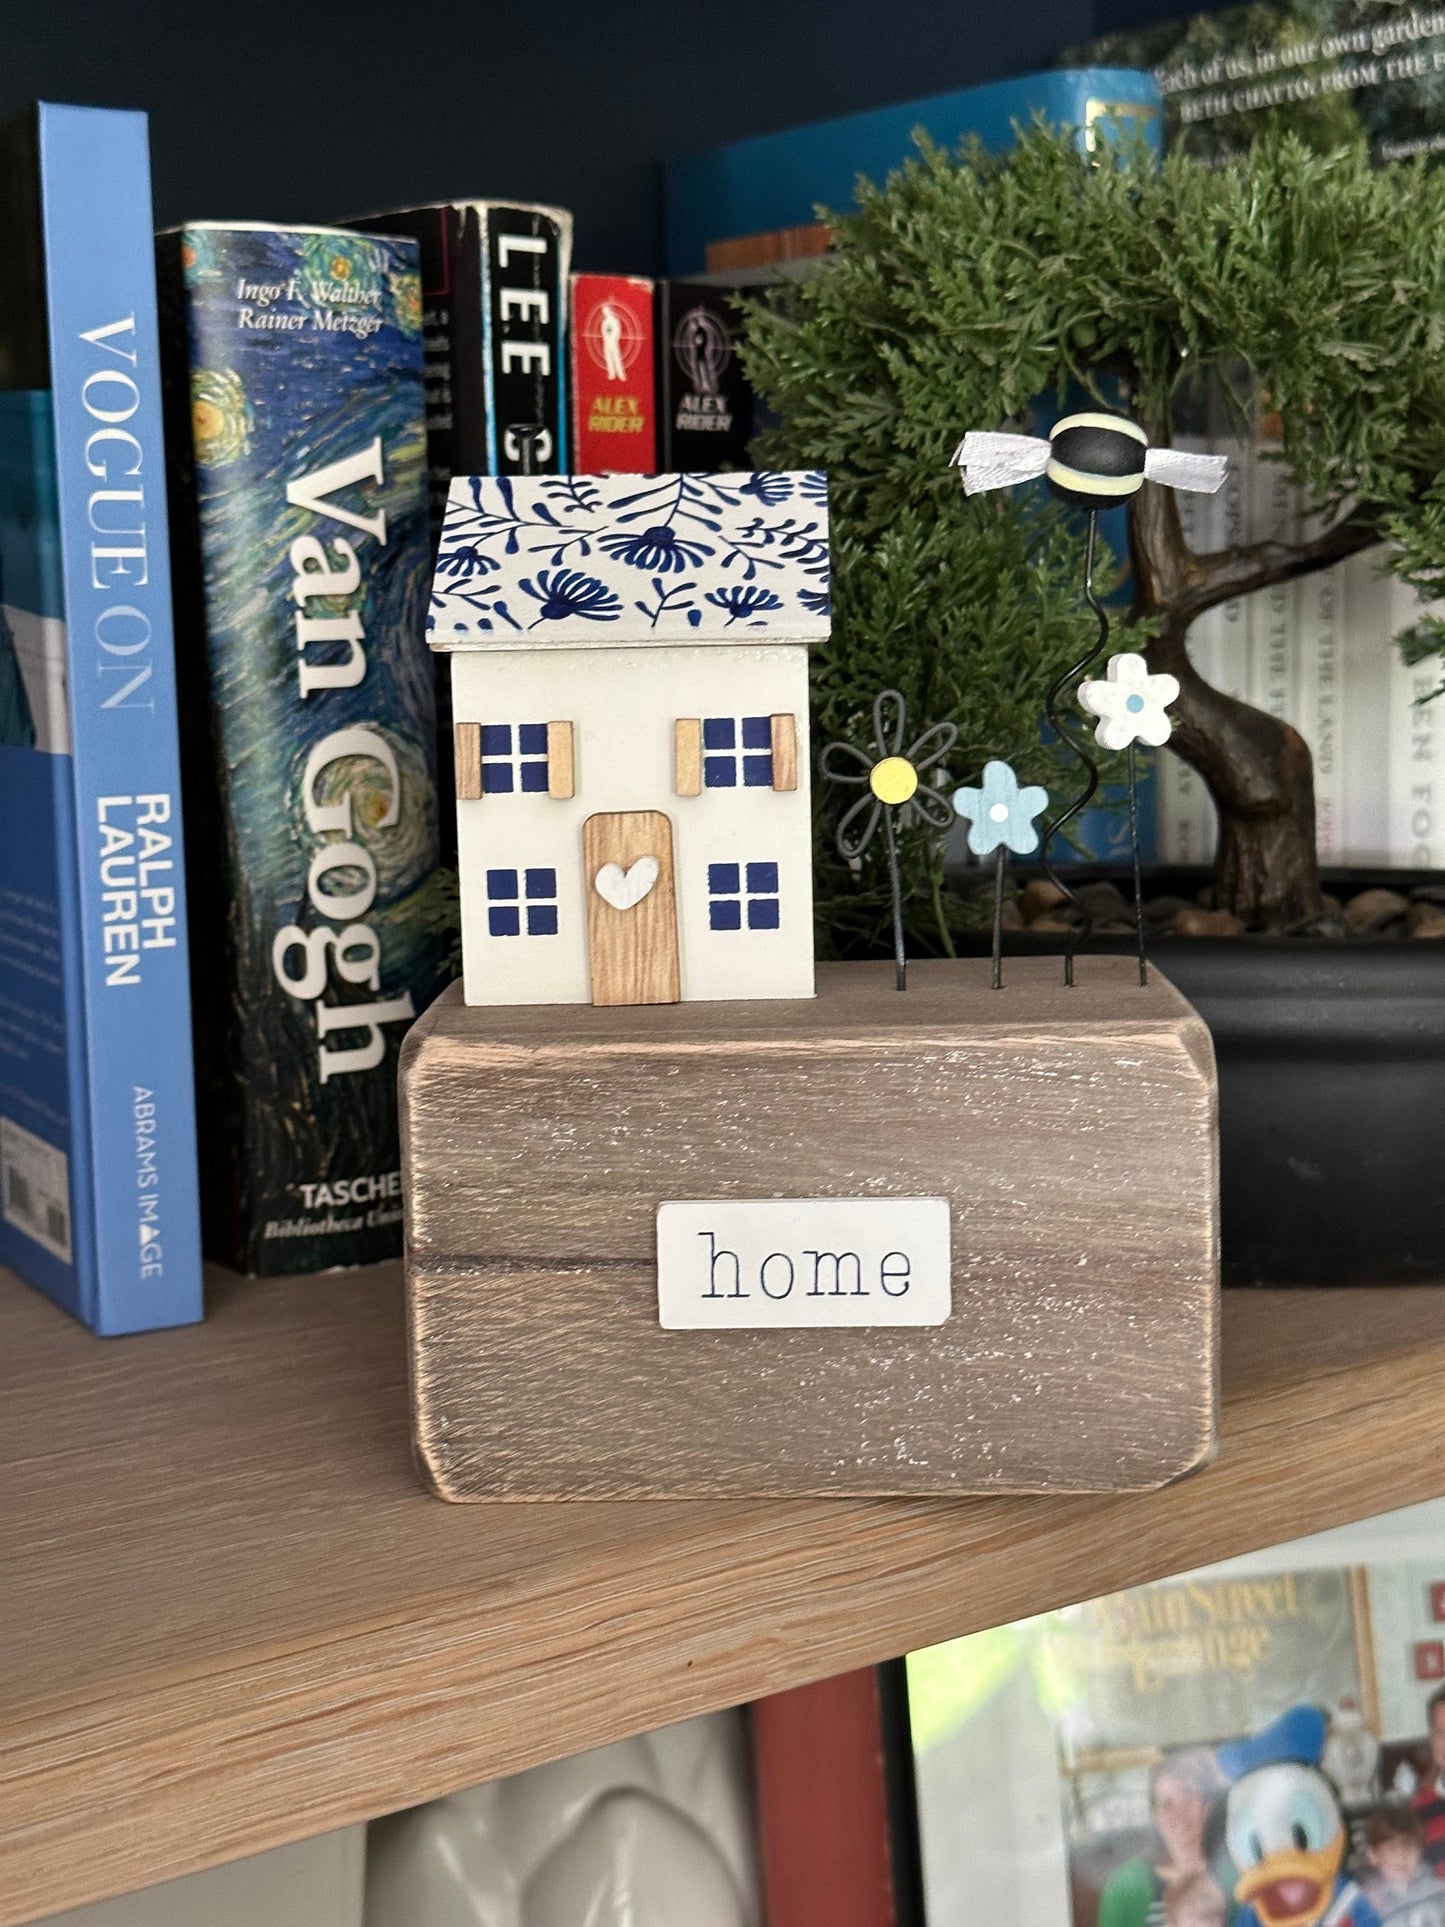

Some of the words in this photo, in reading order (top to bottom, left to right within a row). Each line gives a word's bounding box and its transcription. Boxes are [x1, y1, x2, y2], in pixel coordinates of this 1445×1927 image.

[1281, 43, 1319, 68] our
[1321, 29, 1370, 59] own
[1321, 60, 1381, 95] FROM
[237, 278, 284, 307] Ingo
[310, 280, 382, 305] Walther
[238, 304, 308, 330] Rainer
[499, 233, 550, 377] LEE
[78, 311, 150, 591] VOGUE
[592, 395, 641, 415] ALEX
[678, 394, 728, 414] ALEX
[286, 435, 389, 700] Van
[94, 605, 155, 716] ON
[97, 796, 141, 987] LAUREN
[135, 793, 177, 949] RALPH
[271, 727, 416, 1085] Gogh
[132, 1086, 159, 1188] ABRAMS
[697, 1230, 912, 1300] home
